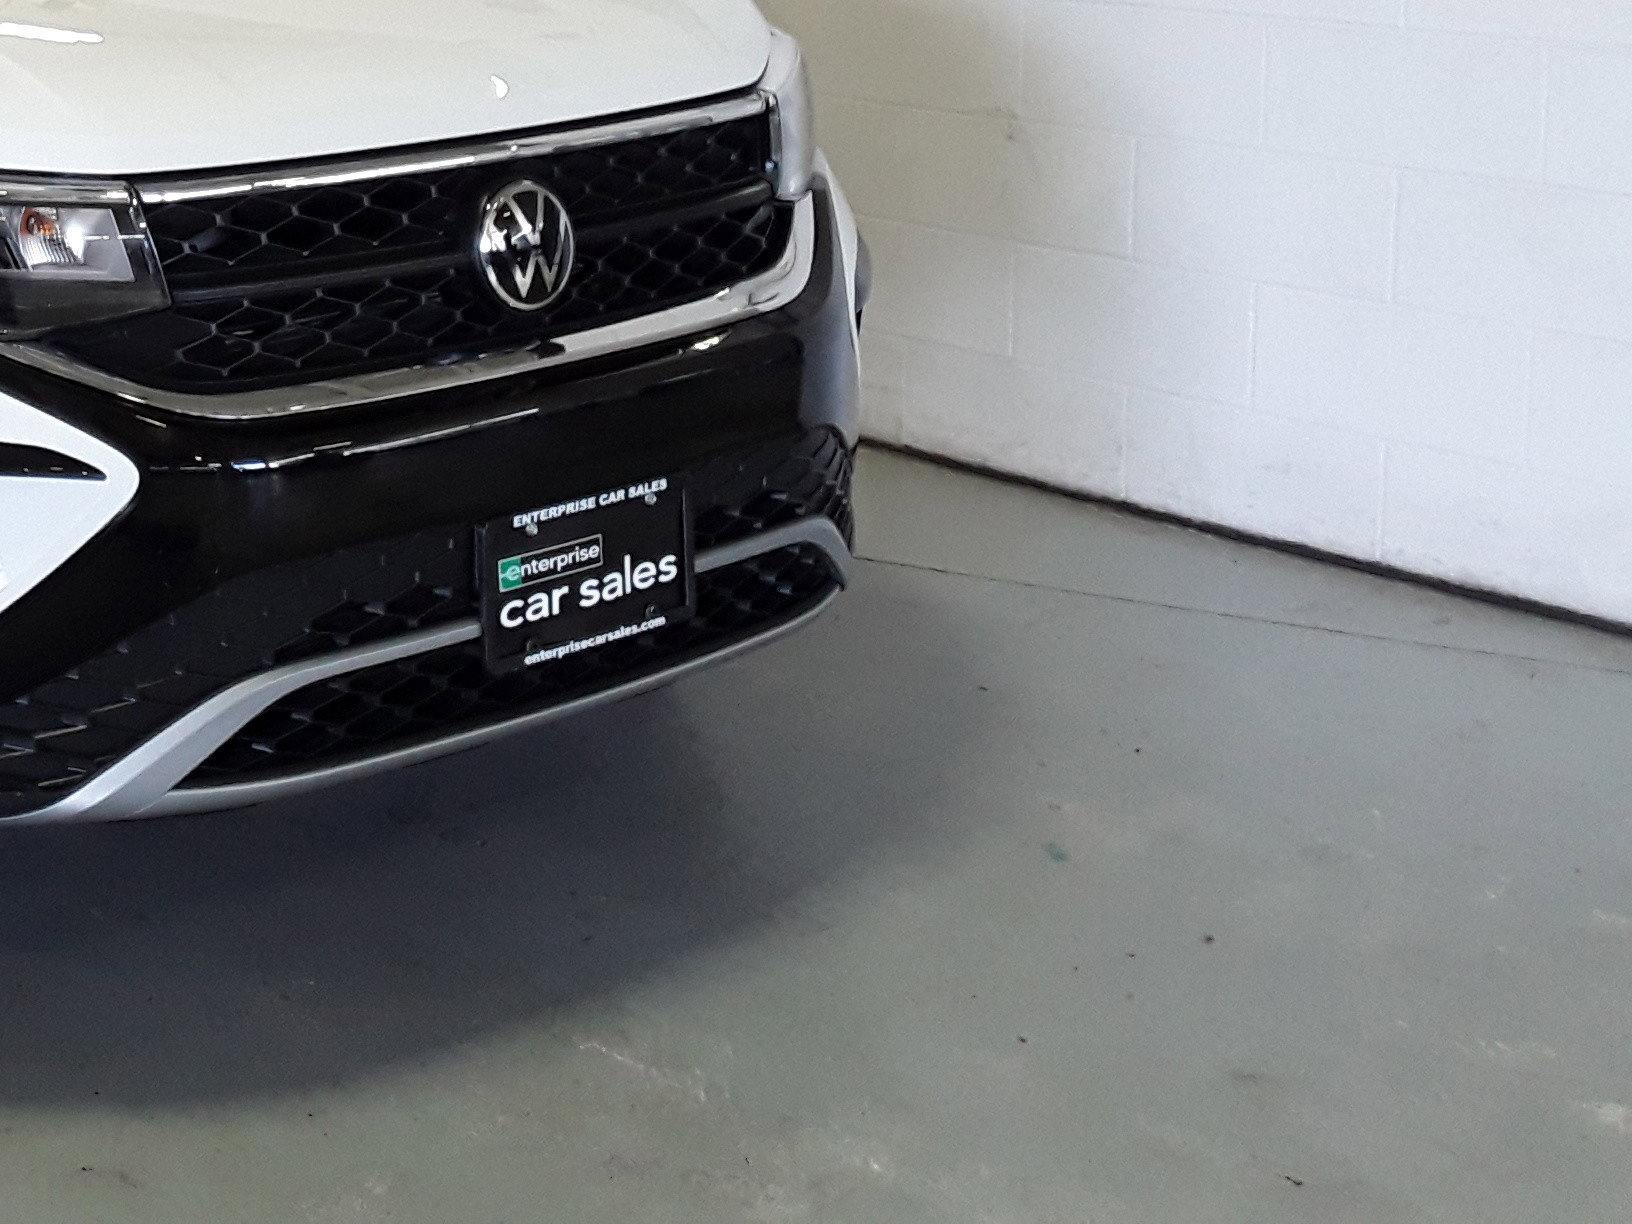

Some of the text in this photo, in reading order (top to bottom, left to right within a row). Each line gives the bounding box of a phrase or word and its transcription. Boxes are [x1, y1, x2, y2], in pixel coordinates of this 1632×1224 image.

[512, 478, 667, 528] ENTERPRISE CAR SALES
[506, 543, 600, 582] enterprise
[499, 553, 678, 629] car sales
[523, 616, 666, 666] enterprisecarsales.com
